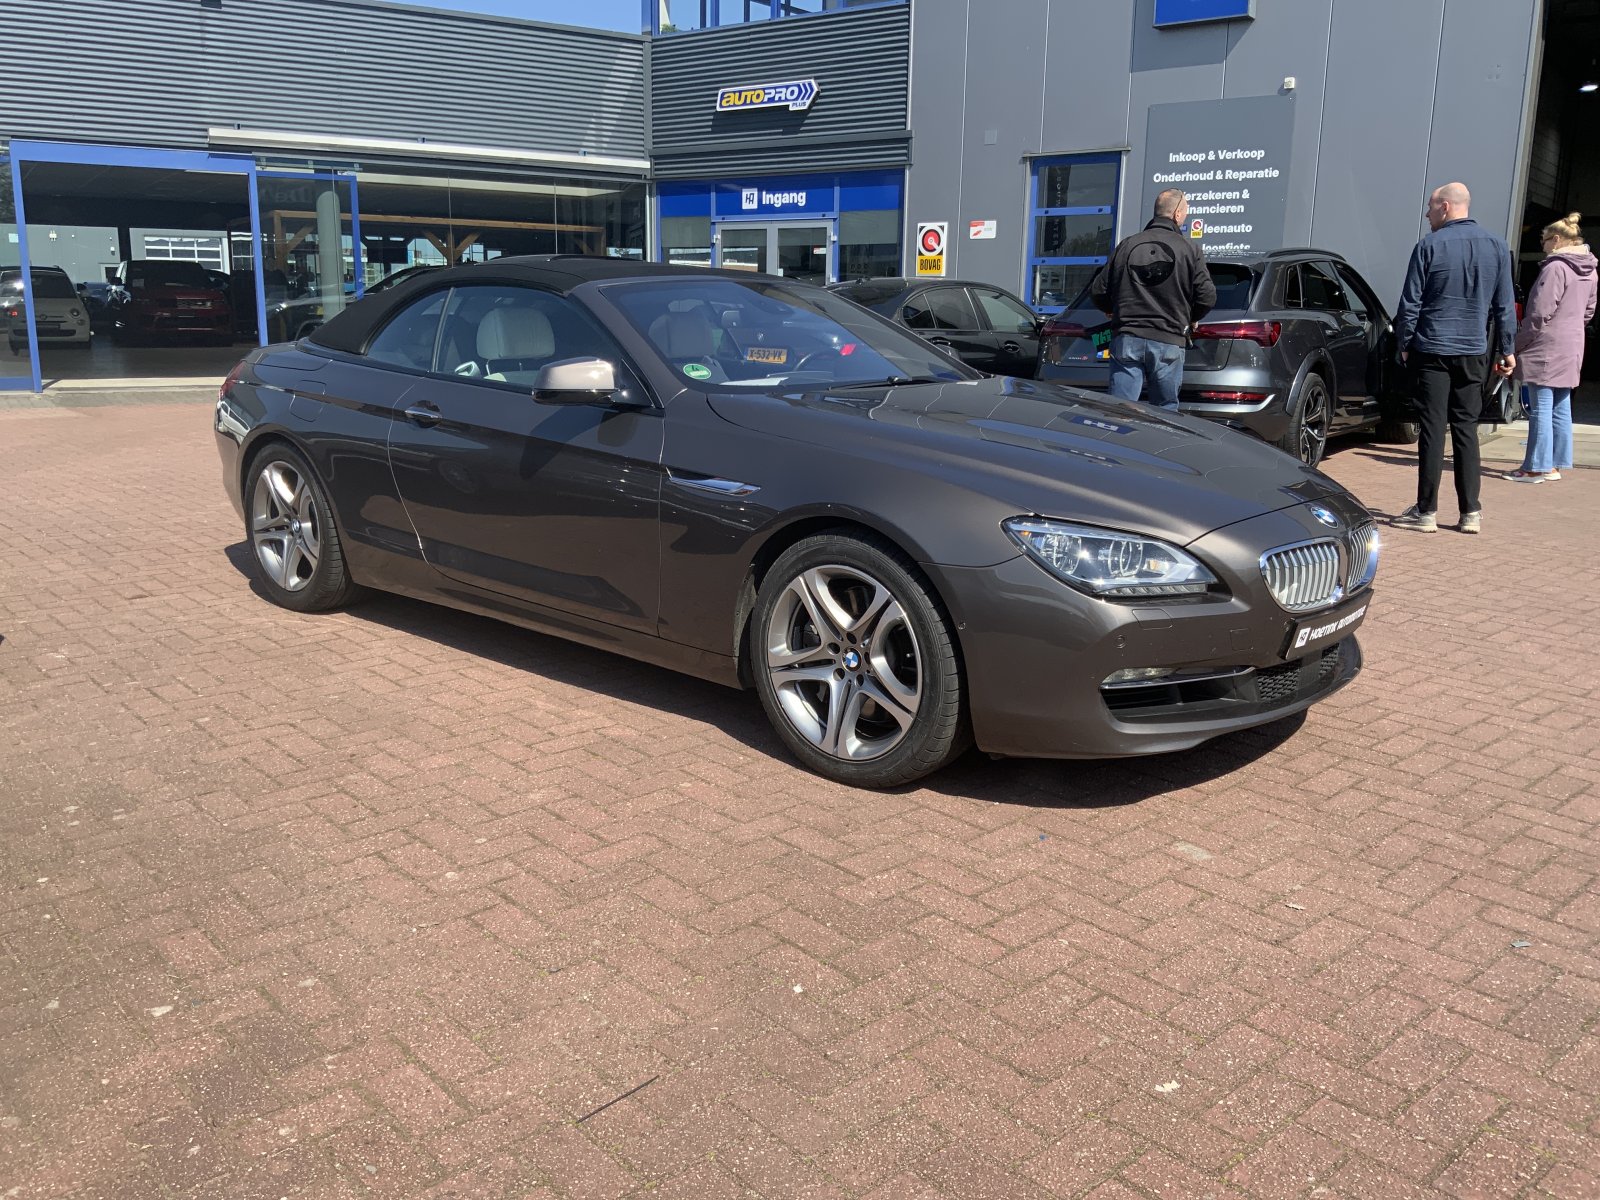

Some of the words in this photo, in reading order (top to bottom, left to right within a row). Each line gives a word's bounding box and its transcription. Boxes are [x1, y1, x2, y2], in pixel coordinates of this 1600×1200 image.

[1168, 152, 1206, 163] Inkoop
[1207, 150, 1216, 161] &
[1217, 148, 1265, 160] Verkoop
[1153, 171, 1214, 183] Onderhoud
[1215, 170, 1223, 180] &
[1224, 167, 1280, 181] Reparatie
[762, 190, 807, 208] Ingang
[1183, 190, 1240, 201] erzekeren
[1241, 188, 1250, 199] &
[1186, 203, 1245, 215] inancieren
[1203, 223, 1253, 234] leenauto
[919, 258, 941, 271] BOVAG
